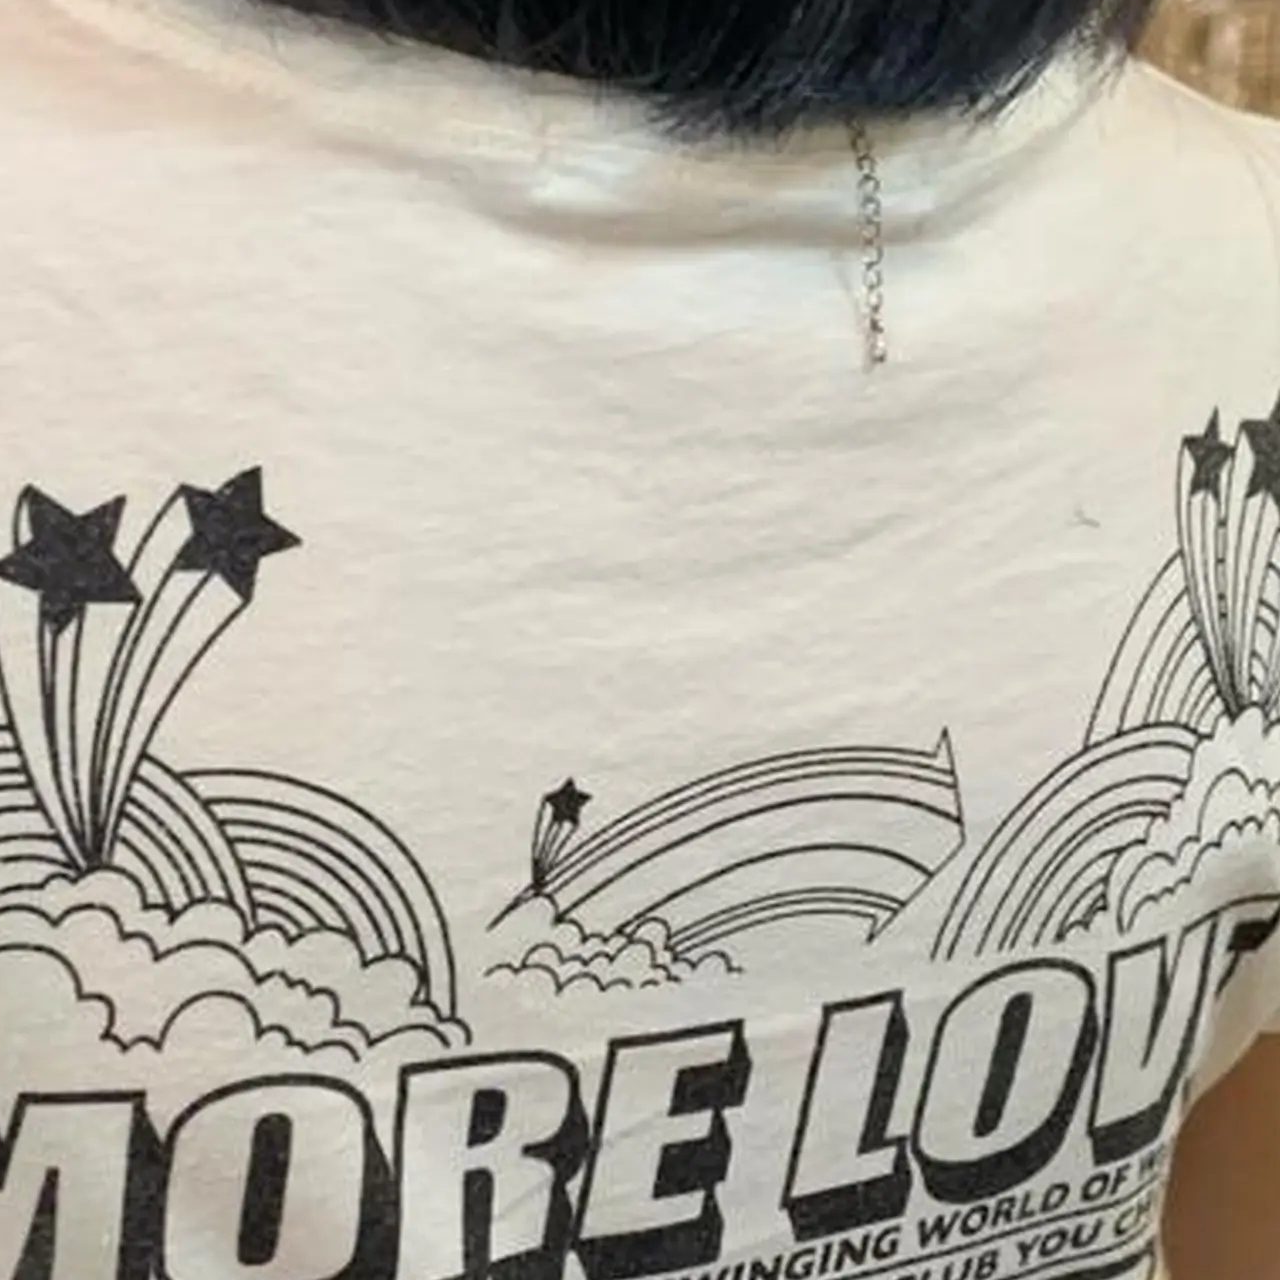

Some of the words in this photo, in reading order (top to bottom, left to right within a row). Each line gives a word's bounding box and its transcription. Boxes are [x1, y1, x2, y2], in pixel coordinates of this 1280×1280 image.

[917, 1181, 1070, 1248] WORLD
[1079, 1164, 1129, 1202] OF
[1015, 1219, 1104, 1267] YOU
